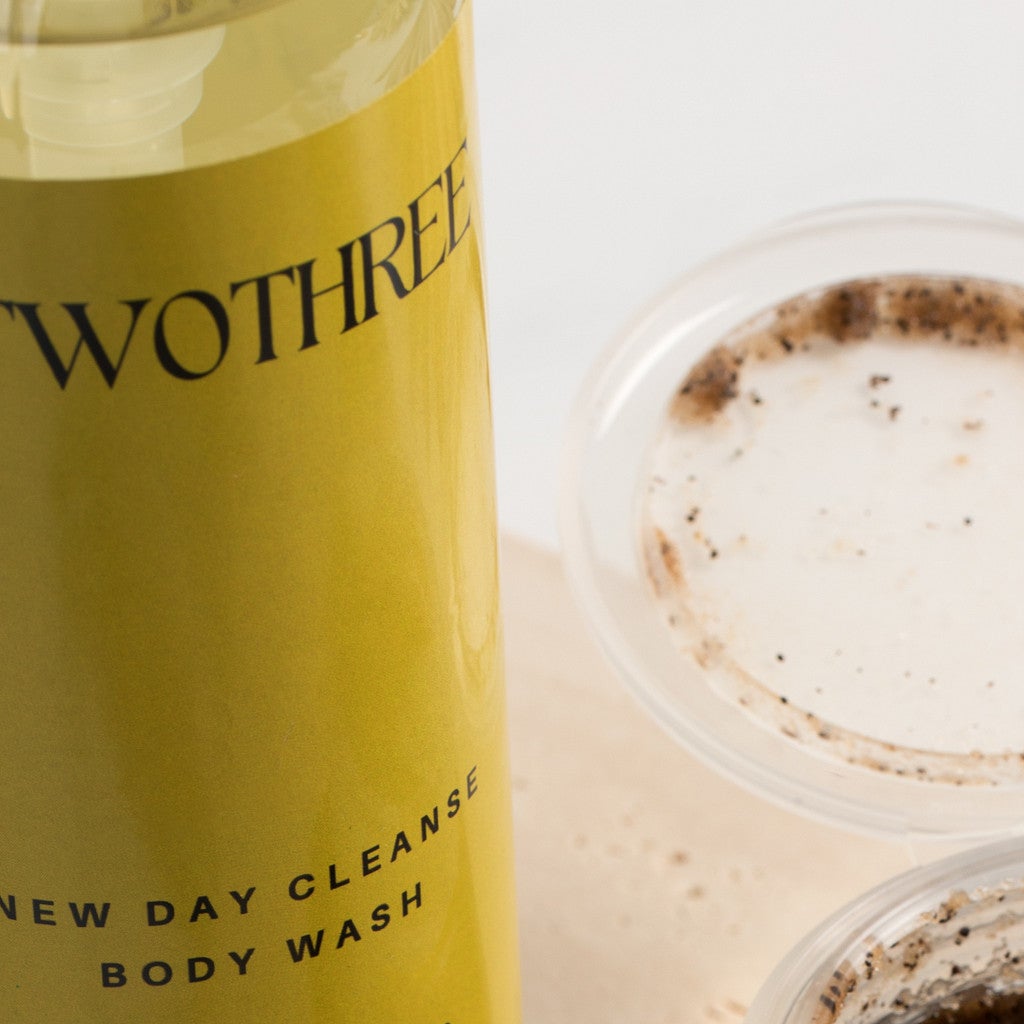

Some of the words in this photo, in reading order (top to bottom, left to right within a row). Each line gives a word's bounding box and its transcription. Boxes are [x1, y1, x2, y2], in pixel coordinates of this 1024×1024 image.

[0, 894, 111, 928] NEW
[147, 887, 256, 927] DAY
[289, 766, 479, 901] CLEANSE
[101, 948, 255, 988] BODY
[287, 882, 423, 964] WASH
